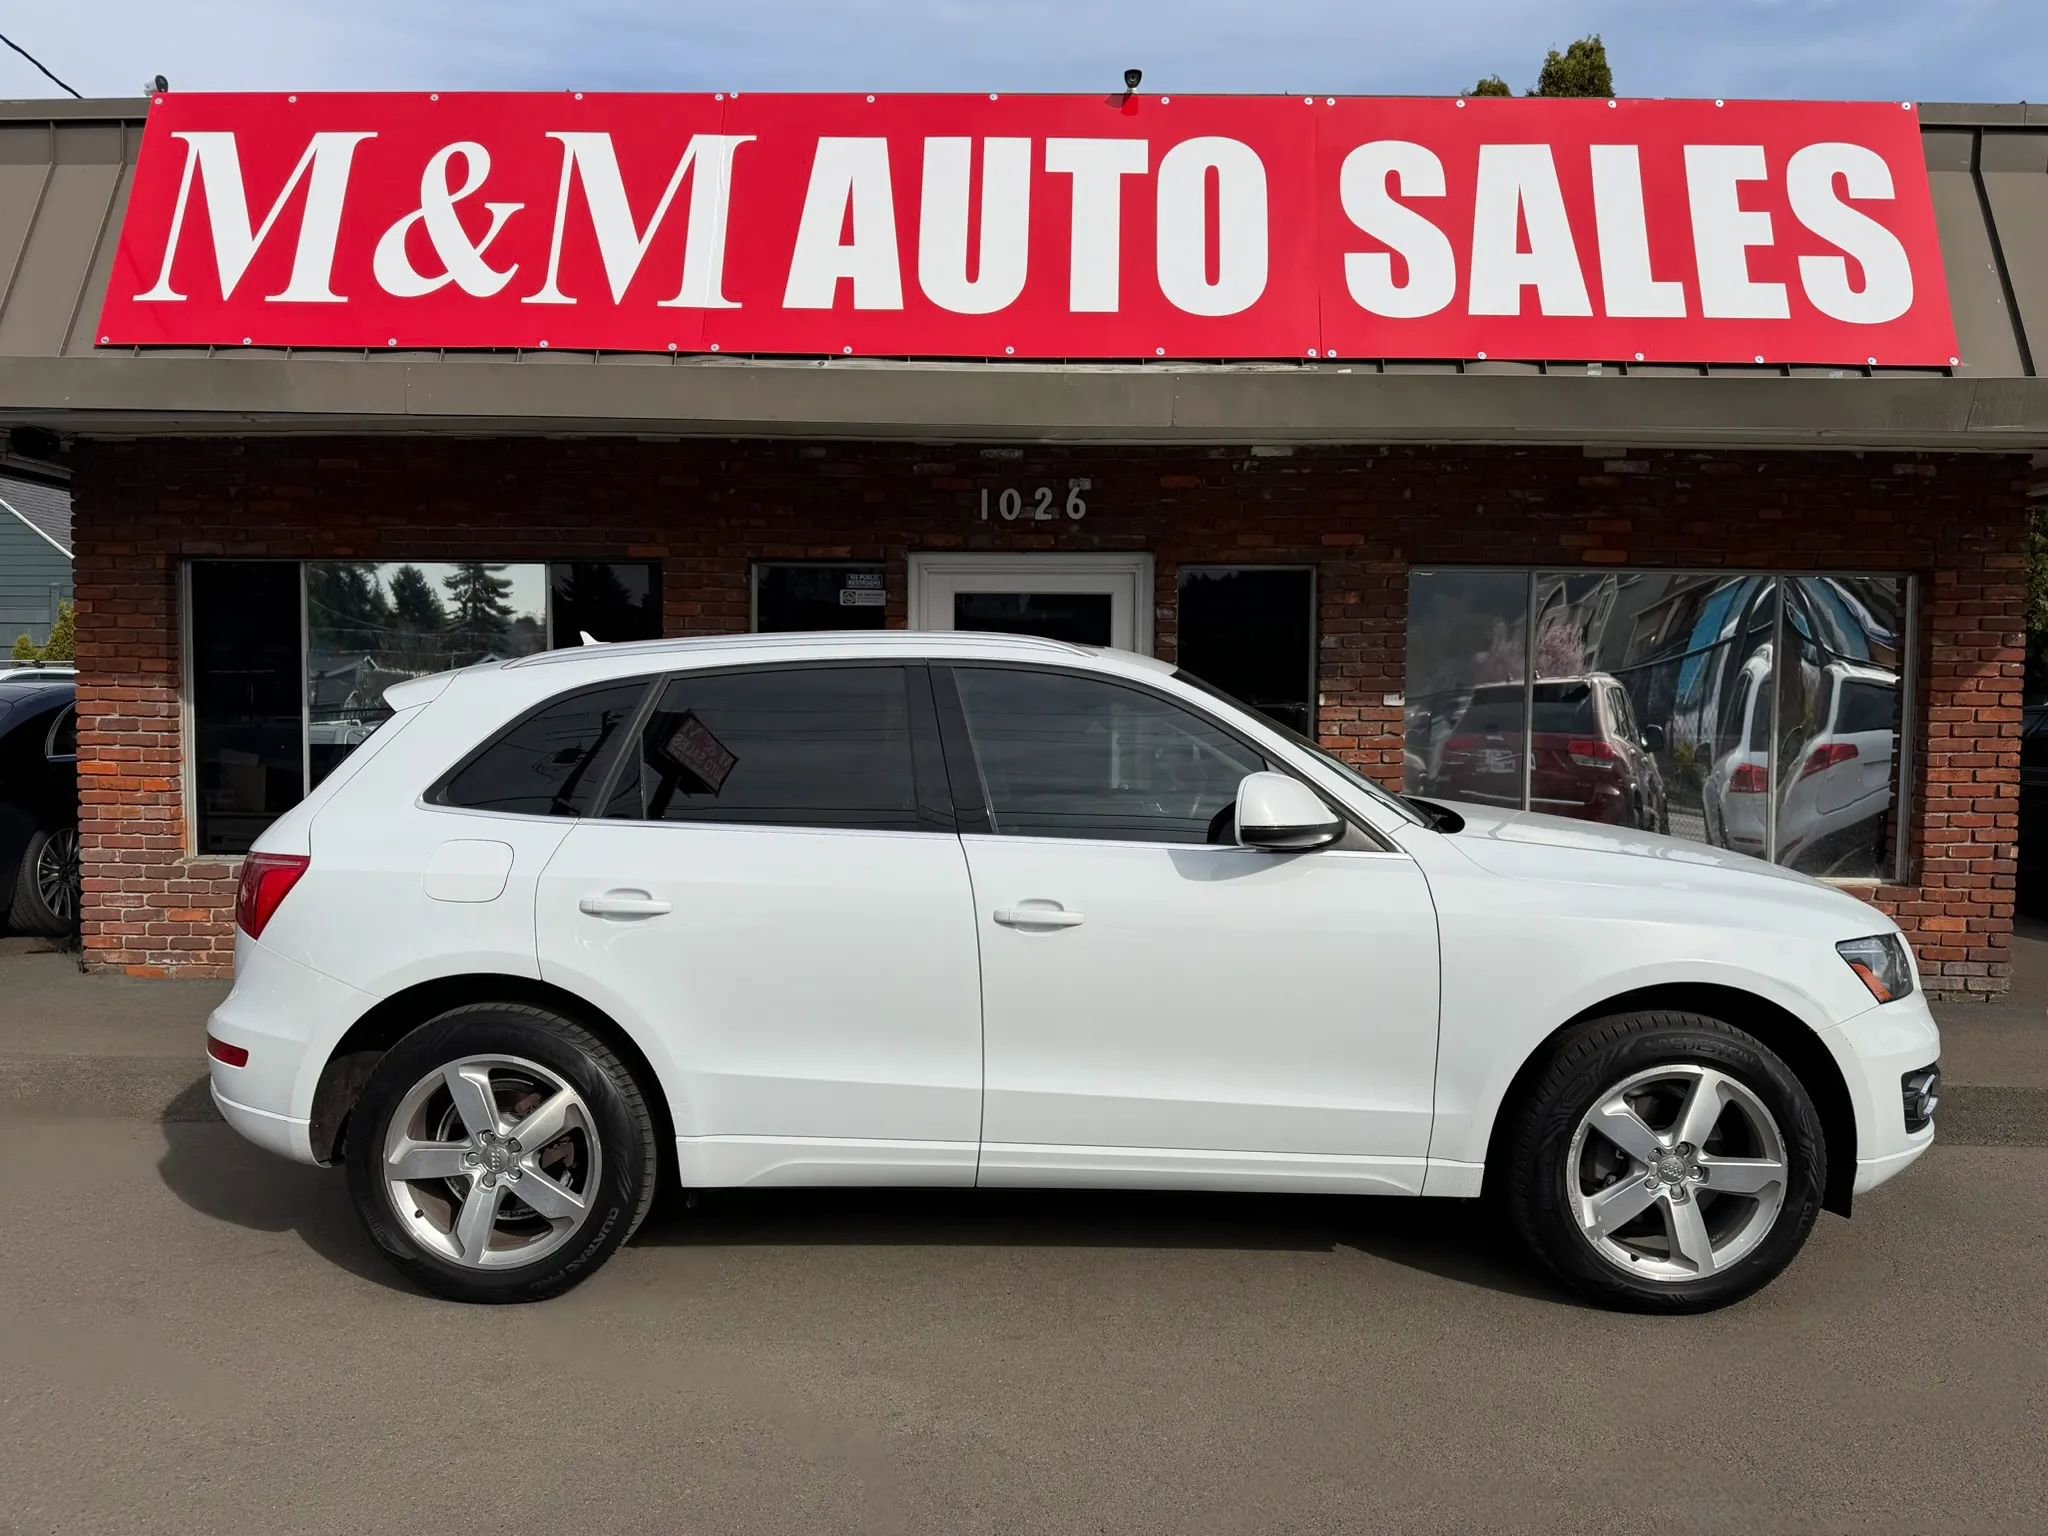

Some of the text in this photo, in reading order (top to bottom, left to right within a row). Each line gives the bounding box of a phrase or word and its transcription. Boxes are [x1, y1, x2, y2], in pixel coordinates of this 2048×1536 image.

[133, 132, 1913, 324] M&M AUTO SALES
[981, 486, 1087, 520] 1026
